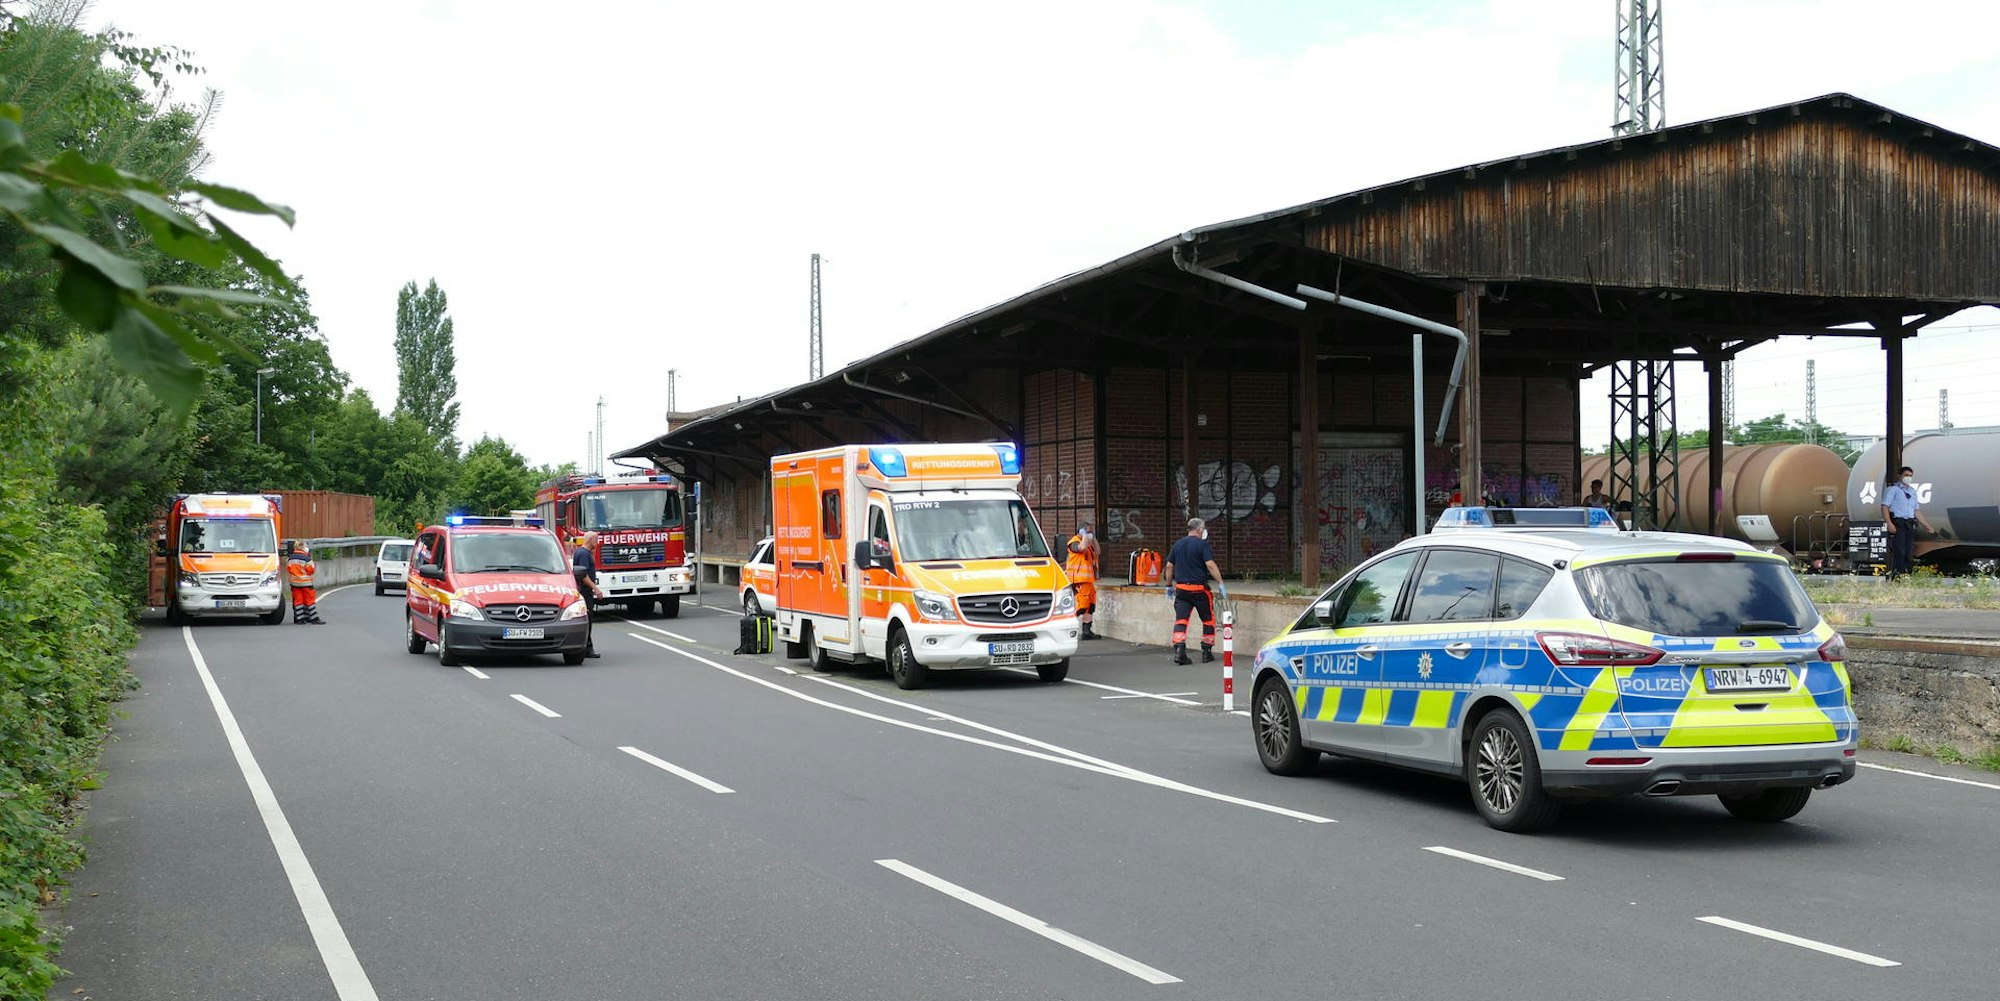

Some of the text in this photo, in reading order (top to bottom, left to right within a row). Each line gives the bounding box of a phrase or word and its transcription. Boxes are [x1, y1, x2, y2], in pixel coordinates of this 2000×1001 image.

[912, 459, 995, 469] RETTUNGSDIENST
[894, 503, 912, 512] TRO
[931, 501, 940, 509] 2
[597, 532, 669, 545] FEUERWEHR
[619, 547, 648, 555] MAN
[464, 583, 573, 596] FEUERWEHR
[507, 629, 516, 637] SU
[519, 629, 528, 637] FW
[994, 643, 1033, 653] SU RD 2832
[1313, 654, 1359, 675] POLIZEI
[1713, 669, 1787, 686] NRW 4-6947
[1621, 678, 1686, 692] POLIZEI
